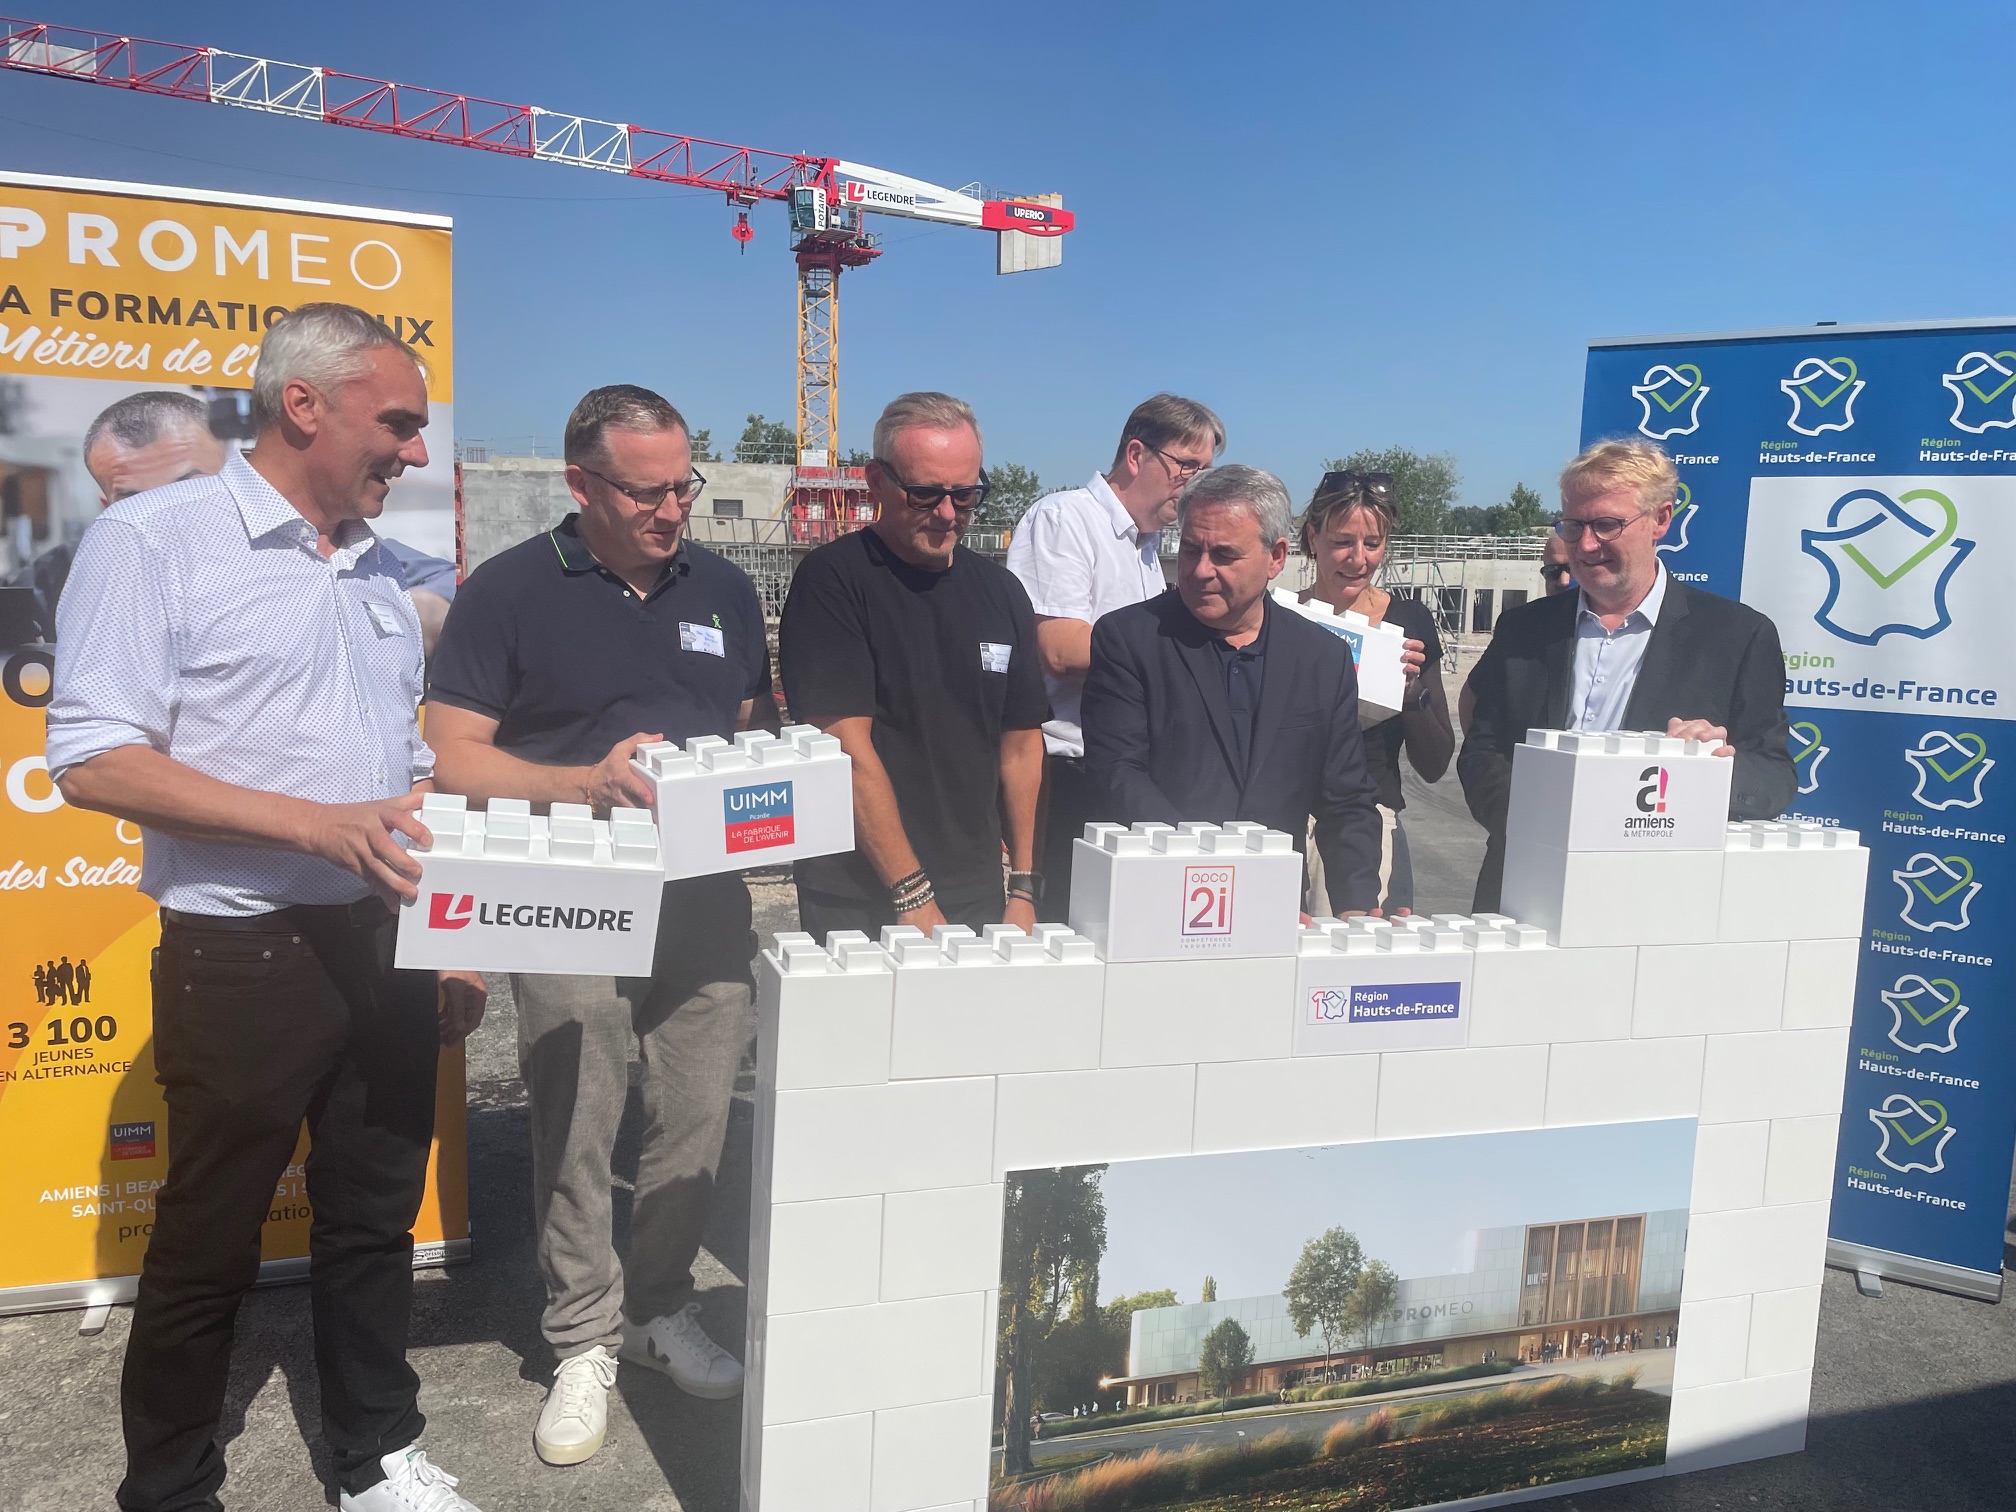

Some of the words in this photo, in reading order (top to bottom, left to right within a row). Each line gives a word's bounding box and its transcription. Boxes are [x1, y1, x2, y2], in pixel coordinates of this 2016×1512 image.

[867, 190, 915, 206] LEGENDRE
[817, 192, 826, 228] POTAIN
[1013, 207, 1045, 221] UPERIO
[0, 206, 402, 290] PROMEO
[0, 284, 32, 315] A
[50, 287, 290, 332] FORMATIO
[0, 322, 152, 371] Métiers
[162, 337, 213, 375] de
[1760, 440, 1798, 451] Région
[1921, 437, 1961, 449] Région
[1759, 451, 1876, 464] Hauts-de-France
[1919, 449, 2016, 462] Hauts-de-Fra
[1785, 677, 1998, 706] auts-de-France
[730, 788, 787, 811] UIMM
[749, 812, 771, 821] Picardie
[1624, 813, 1675, 829] amiens
[1884, 809, 1923, 822] Région
[731, 831, 743, 839] LA
[743, 824, 781, 837] FABRIQUE
[743, 836, 754, 844] DE
[756, 830, 789, 842] L'AVENIR
[1623, 829, 1629, 838] &
[1882, 821, 2006, 844] Hauts-de-France
[0, 860, 48, 891] des
[55, 856, 142, 888] Sala
[1191, 872, 1228, 884] opco
[1189, 886, 1227, 928] 2i
[479, 902, 634, 932] LEGENDRE
[1872, 928, 1911, 942] Région
[1870, 940, 1993, 967] Hauts-de-France
[1354, 991, 1389, 1004] Région
[1353, 1002, 1455, 1018] Hauts-de-France
[7, 1022, 30, 1049] 3
[47, 1015, 118, 1046] 100
[33, 1047, 94, 1066] JEUNES
[1860, 1047, 1899, 1062] Région
[0, 1070, 17, 1082] EN
[22, 1061, 131, 1081] ALTERNANCE
[1859, 1059, 1980, 1090] Hauts-de-France
[114, 1125, 151, 1138] UIMM
[1849, 1165, 1887, 1181] Région
[39, 1184, 110, 1203] AMIENS
[1847, 1177, 1966, 1211] Hauts-de-France
[1393, 1300, 1474, 1322] PROMEO
